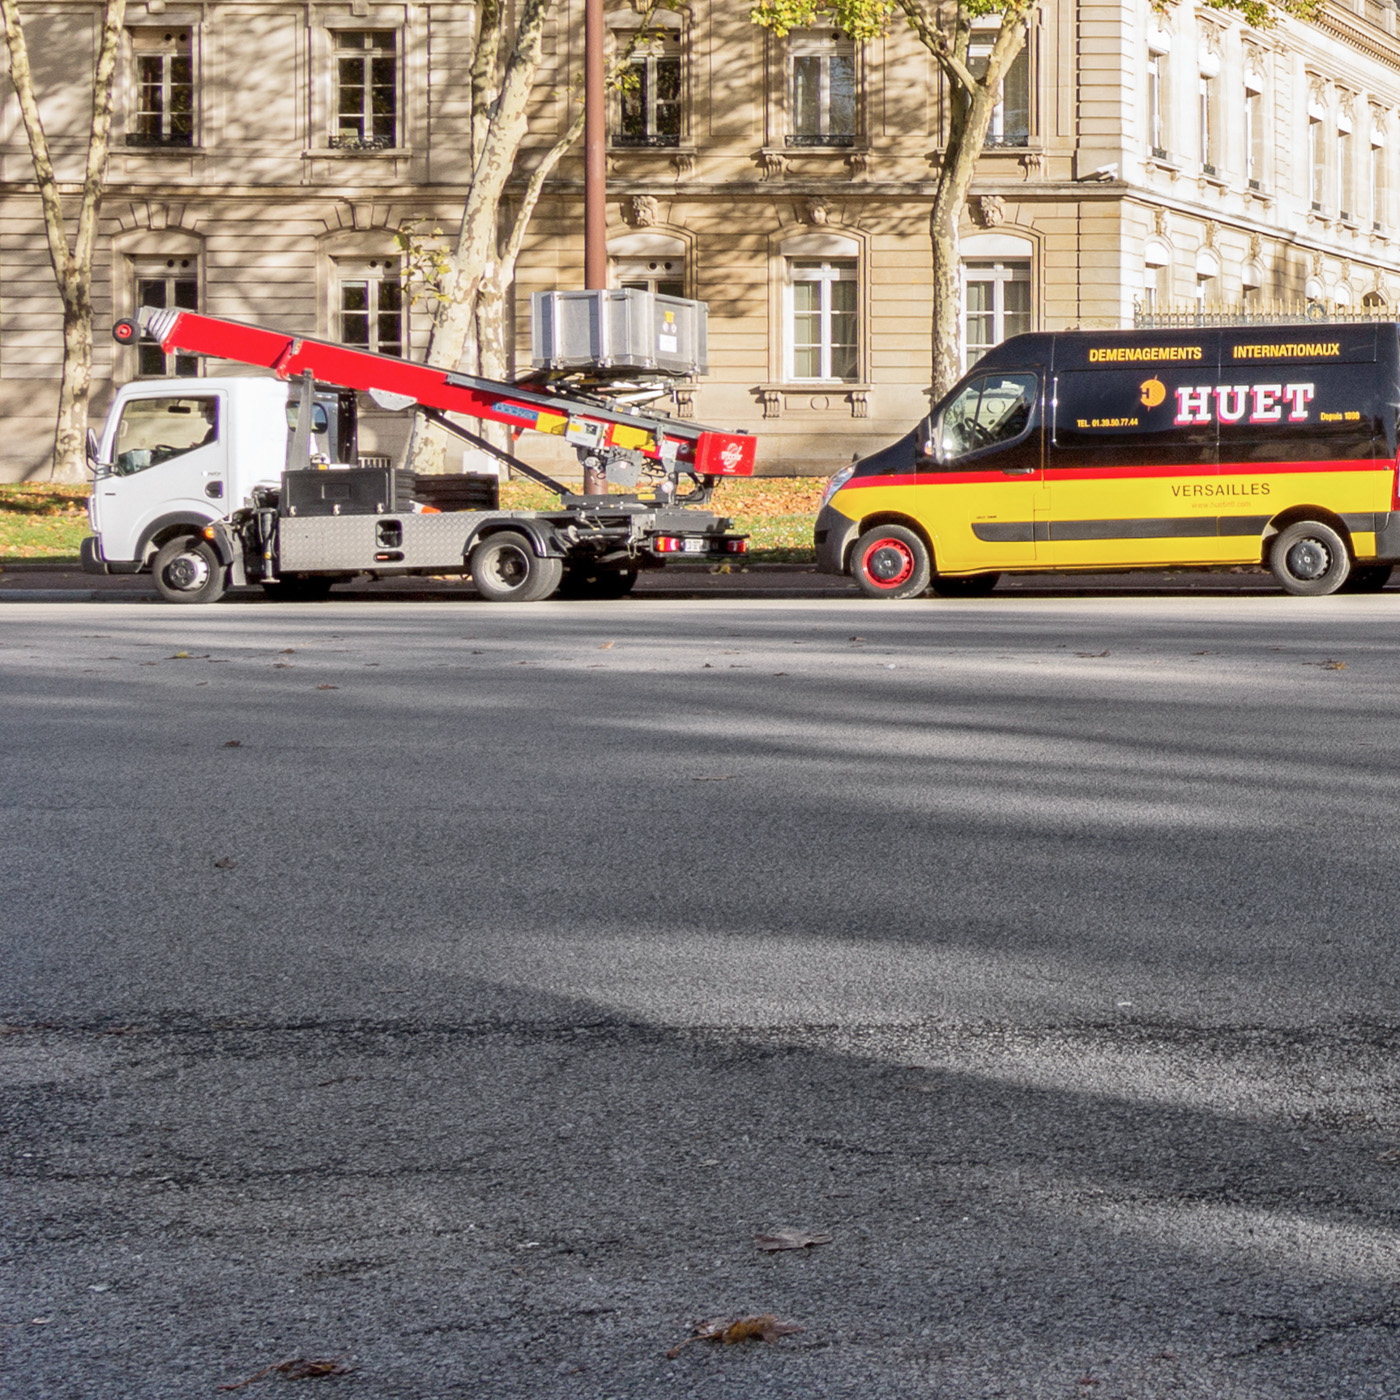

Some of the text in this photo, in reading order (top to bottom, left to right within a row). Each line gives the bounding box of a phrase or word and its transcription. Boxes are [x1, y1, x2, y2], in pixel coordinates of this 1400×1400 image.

[1088, 342, 1340, 363] DEMENAGEMENTS INTERNATIONAUX
[1173, 382, 1315, 427] HUET
[1171, 482, 1271, 497] VERSAILLES
